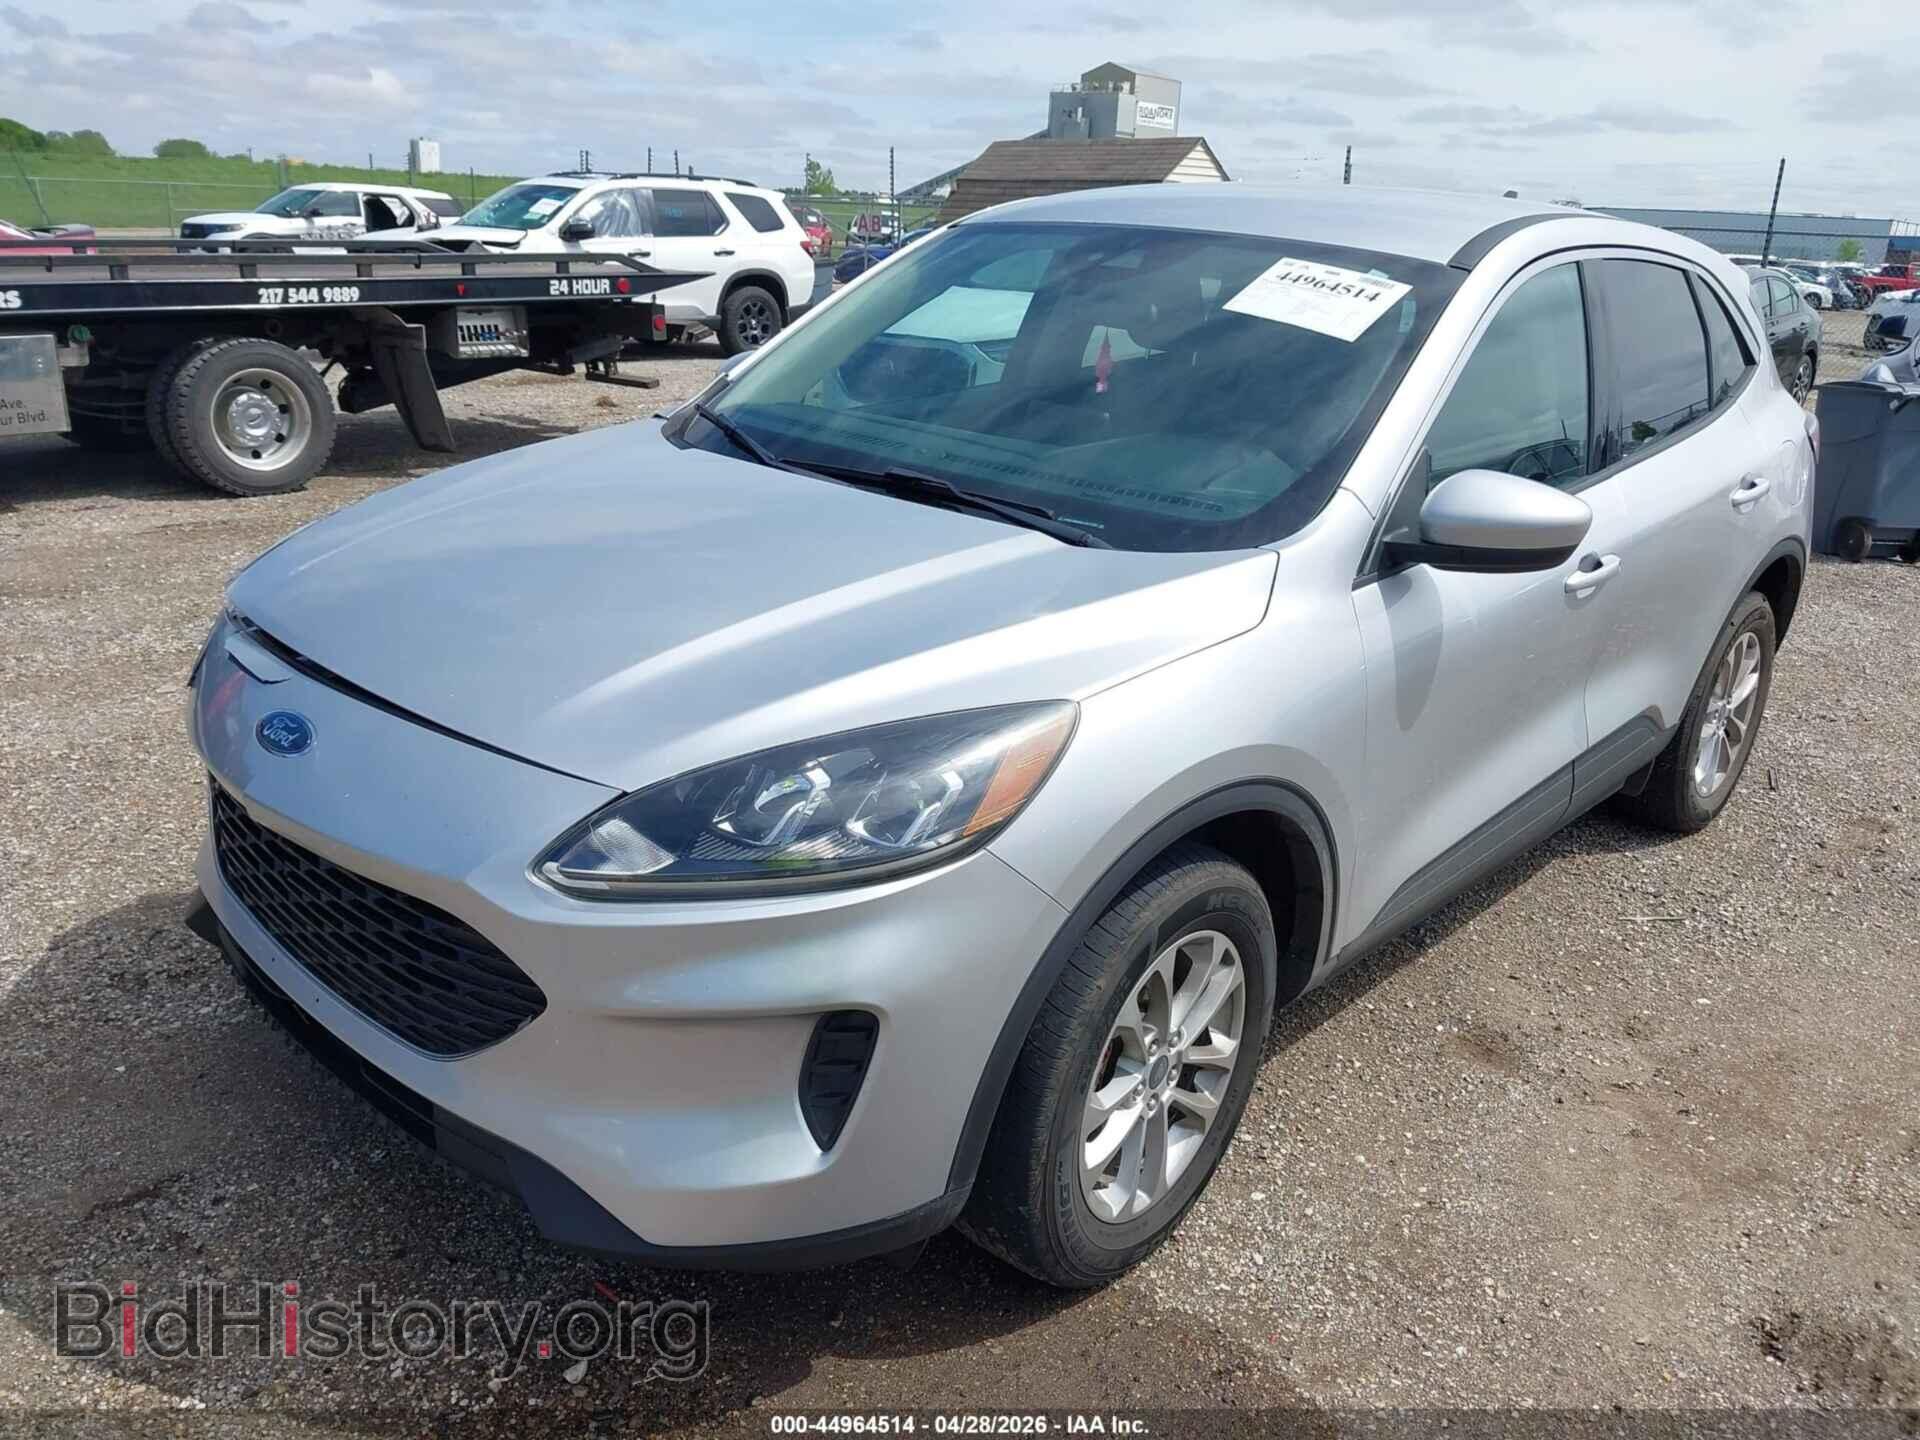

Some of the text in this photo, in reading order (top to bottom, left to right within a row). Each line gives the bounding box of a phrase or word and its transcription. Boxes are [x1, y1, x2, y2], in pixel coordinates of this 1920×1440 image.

[258, 286, 360, 304] 217 544 9889
[549, 278, 610, 296] 24 HOUR
[1276, 271, 1381, 302] 44964514
[16, 409, 49, 424] Blvd.
[263, 717, 301, 747] Ford
